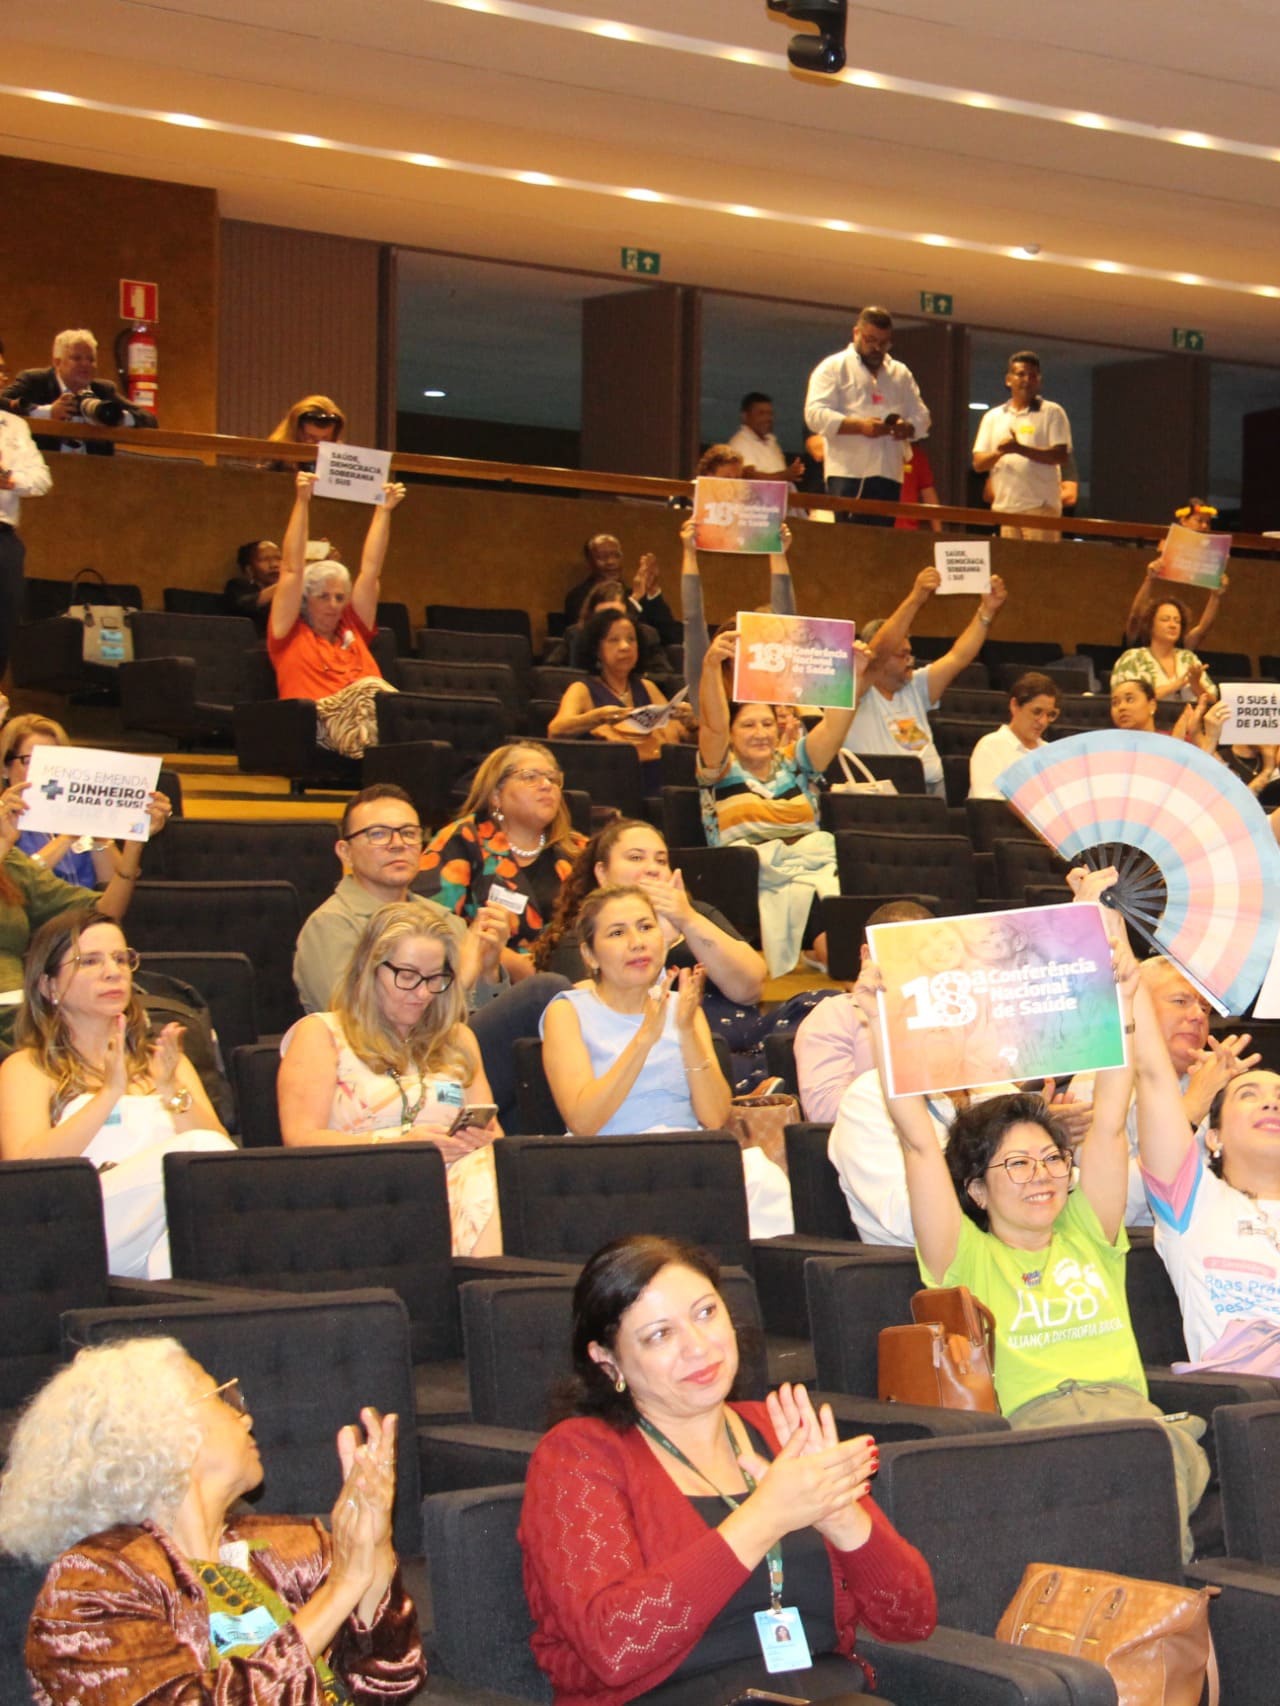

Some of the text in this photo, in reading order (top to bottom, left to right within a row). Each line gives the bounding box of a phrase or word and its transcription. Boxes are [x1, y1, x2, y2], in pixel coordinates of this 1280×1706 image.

[1236, 691, 1278, 705] O SUS É
[1236, 717, 1279, 729] DE PAÍS
[94, 770, 149, 788] EMENDA
[69, 781, 147, 800] DINHEIRO
[67, 794, 143, 809] PARA O SUS!
[900, 957, 1098, 1031] 18ª Conferência
[990, 979, 1071, 1002] Nacional
[992, 995, 1078, 1019] de Saúde
